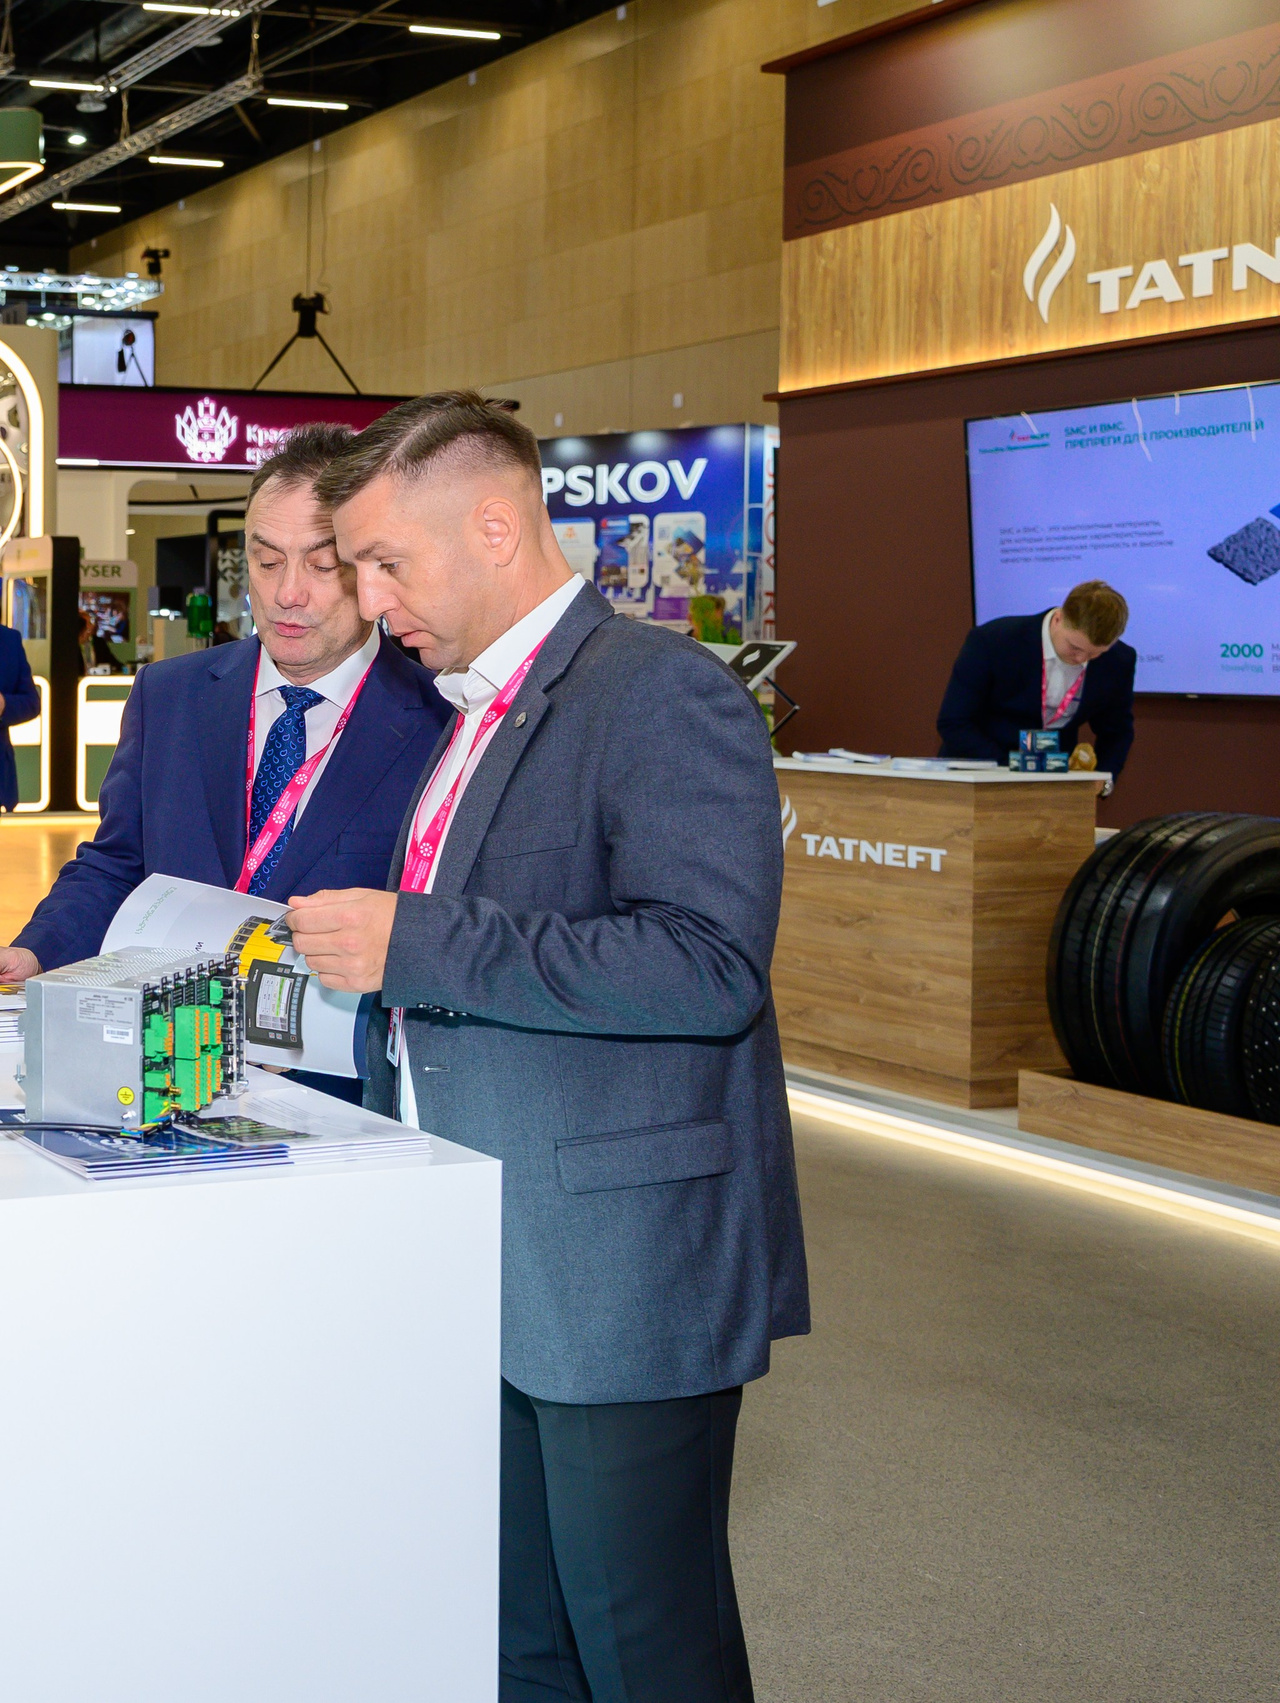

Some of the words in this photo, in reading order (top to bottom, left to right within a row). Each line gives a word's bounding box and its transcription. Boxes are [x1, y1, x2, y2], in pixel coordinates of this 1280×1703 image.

[1065, 435, 1122, 450] ПРЕПРЕГИ
[541, 458, 708, 507] PSKOV
[1220, 643, 1263, 658] 2000
[802, 834, 947, 872] TATNEFT
